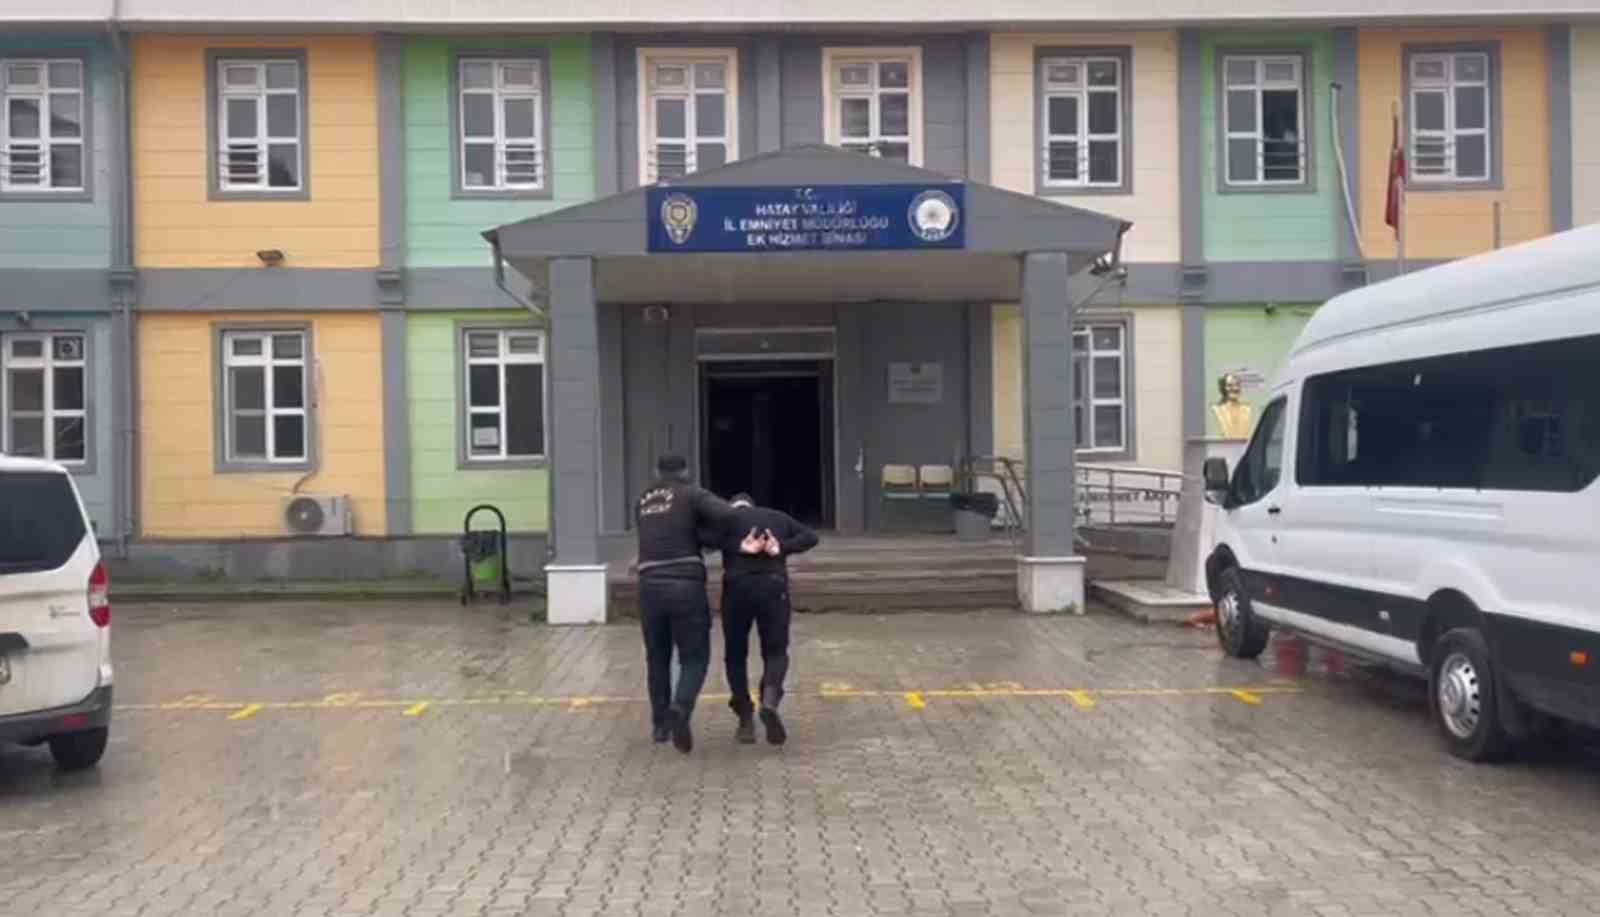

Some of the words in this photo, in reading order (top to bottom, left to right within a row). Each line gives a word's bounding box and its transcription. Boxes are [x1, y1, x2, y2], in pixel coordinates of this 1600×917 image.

[755, 203, 799, 216] HATAY
[723, 216, 736, 231] İL
[746, 233, 766, 246] EK
